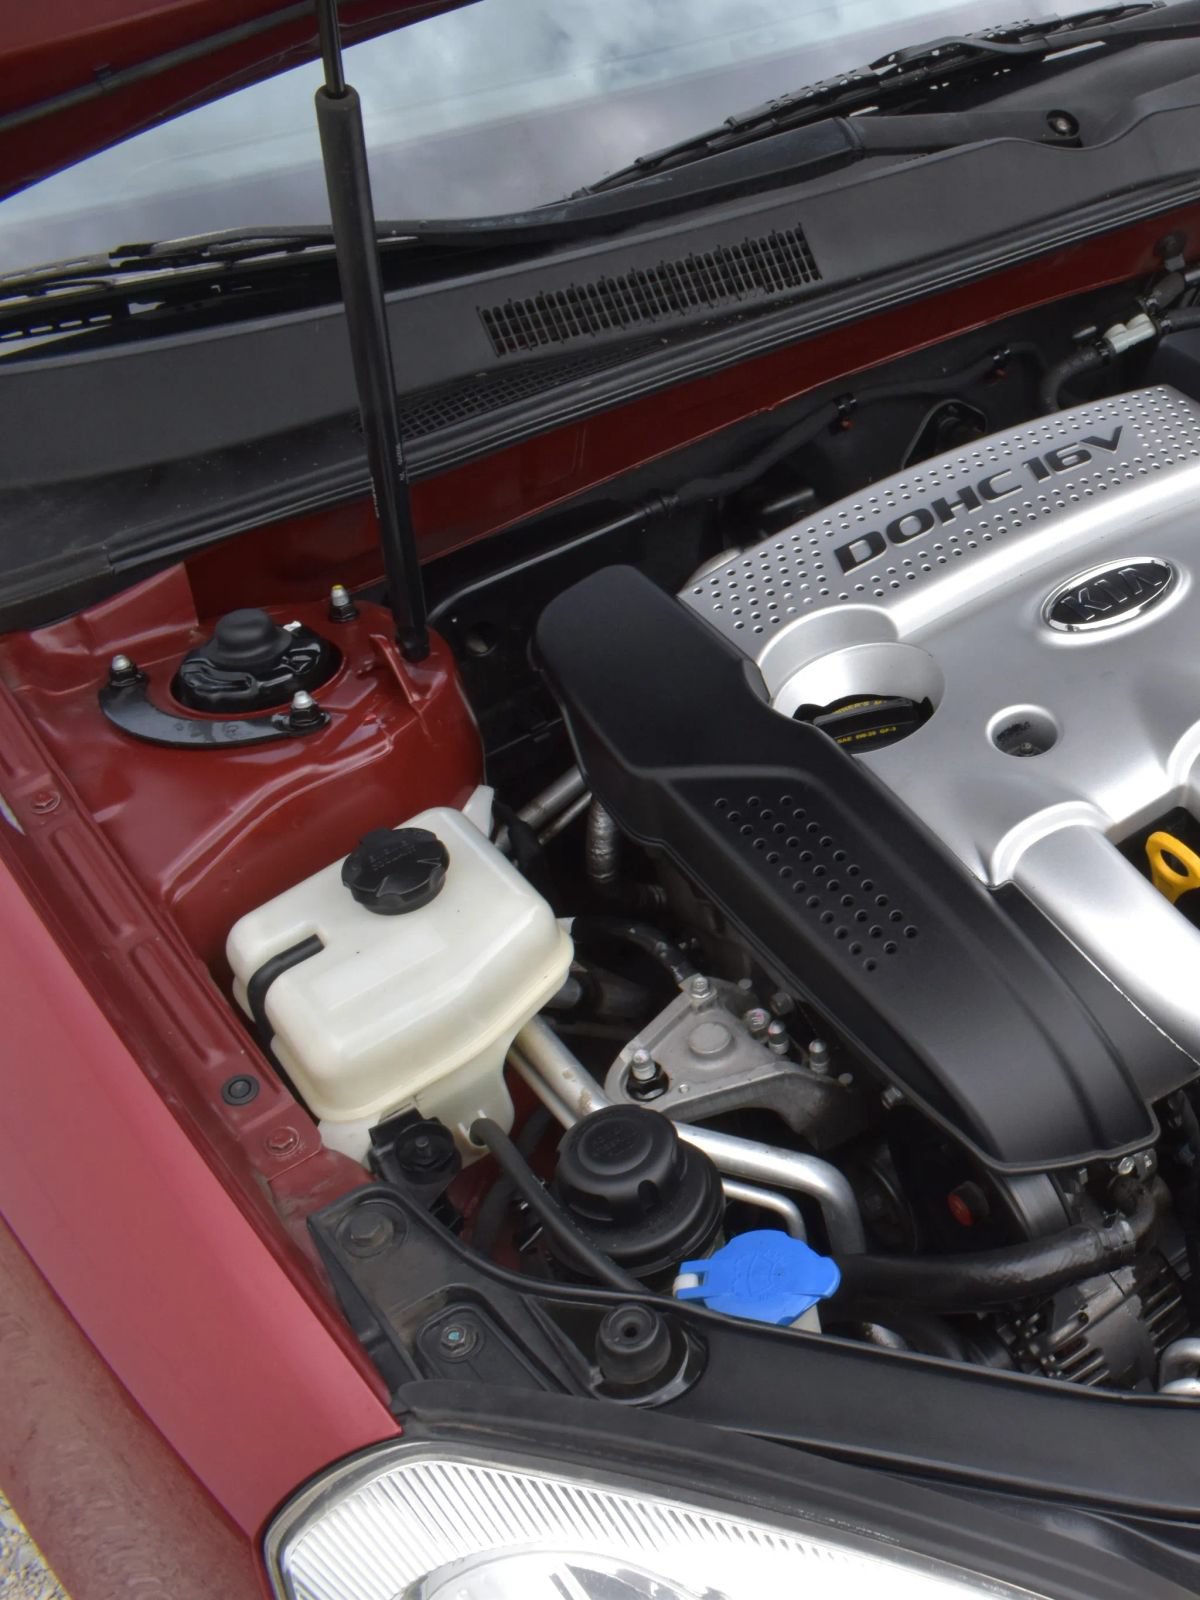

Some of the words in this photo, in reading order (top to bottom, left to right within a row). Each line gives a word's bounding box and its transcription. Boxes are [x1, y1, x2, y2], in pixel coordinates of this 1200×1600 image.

[833, 469, 1023, 576] DOHC
[1022, 425, 1124, 485] 16V
[1060, 566, 1163, 621] KIA
